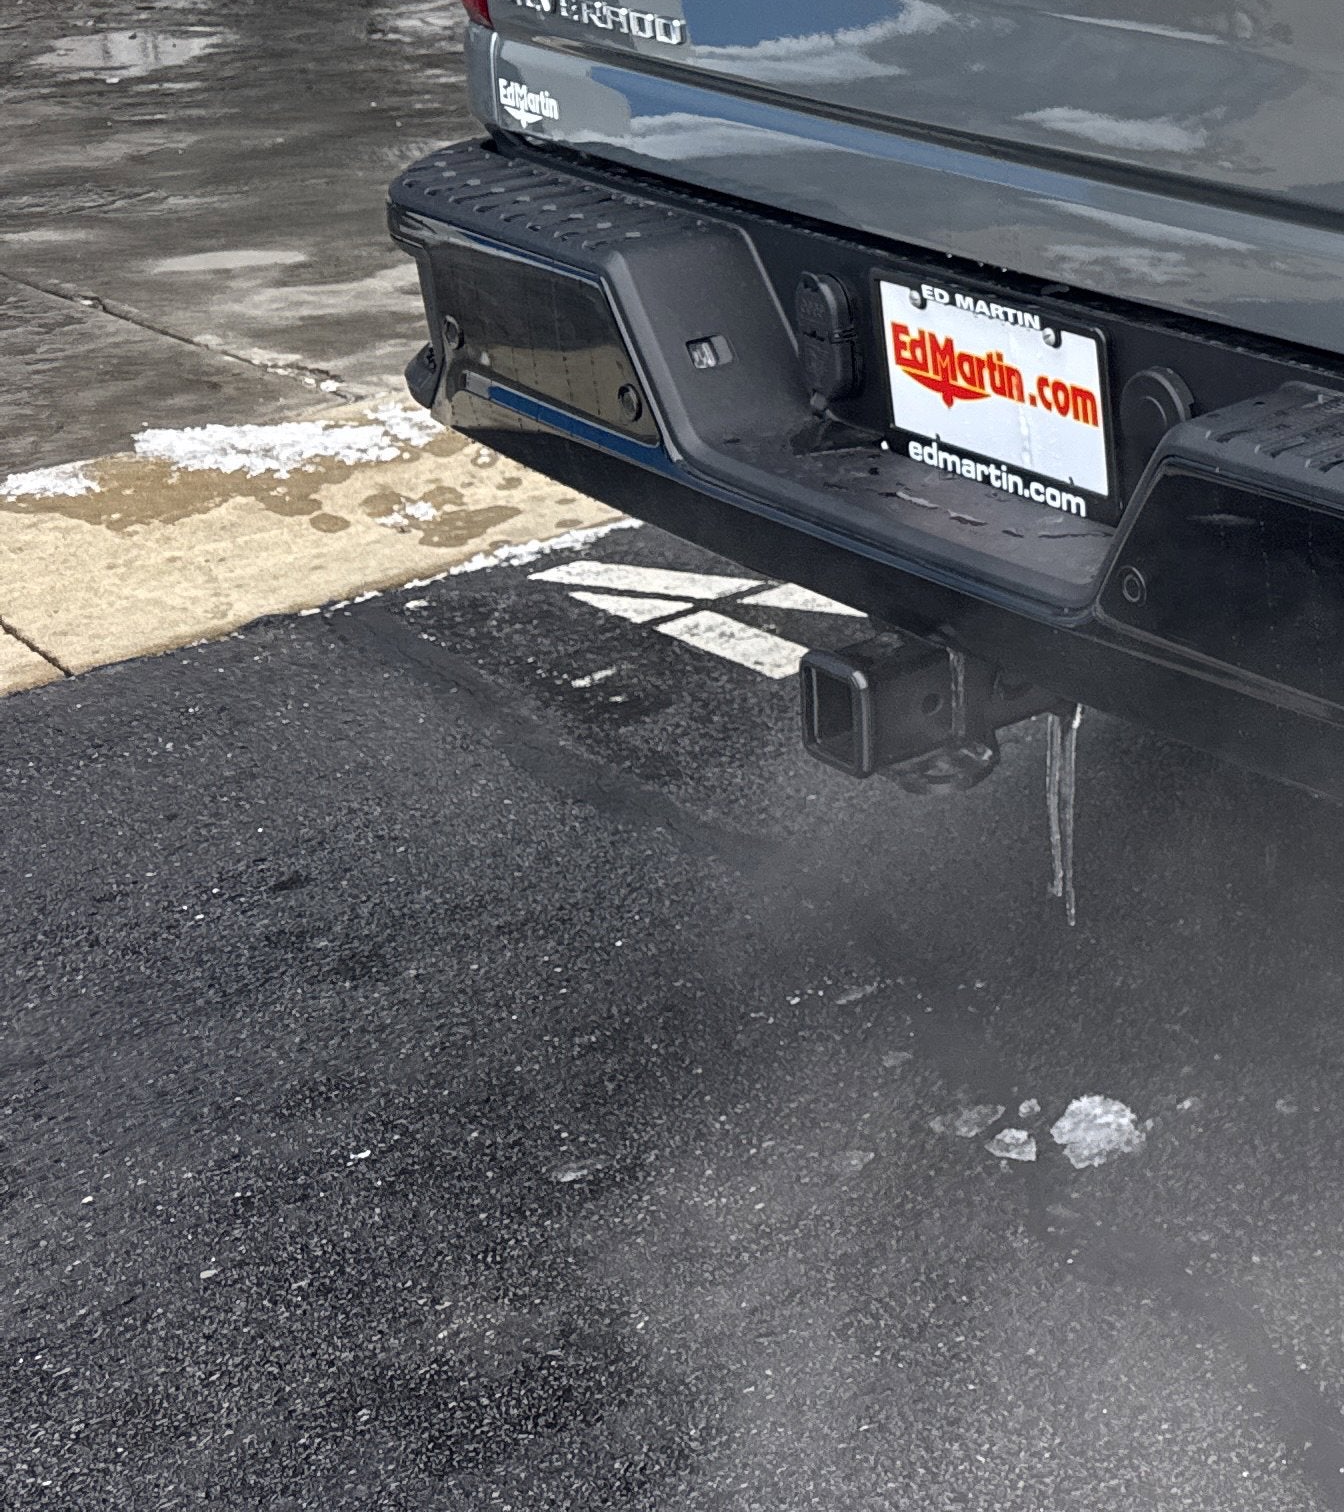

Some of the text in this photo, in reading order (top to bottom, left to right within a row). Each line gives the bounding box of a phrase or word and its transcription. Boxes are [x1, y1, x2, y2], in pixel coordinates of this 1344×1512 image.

[920, 284, 1042, 330] ED MARTIN
[908, 440, 1087, 518] edmartin.com
